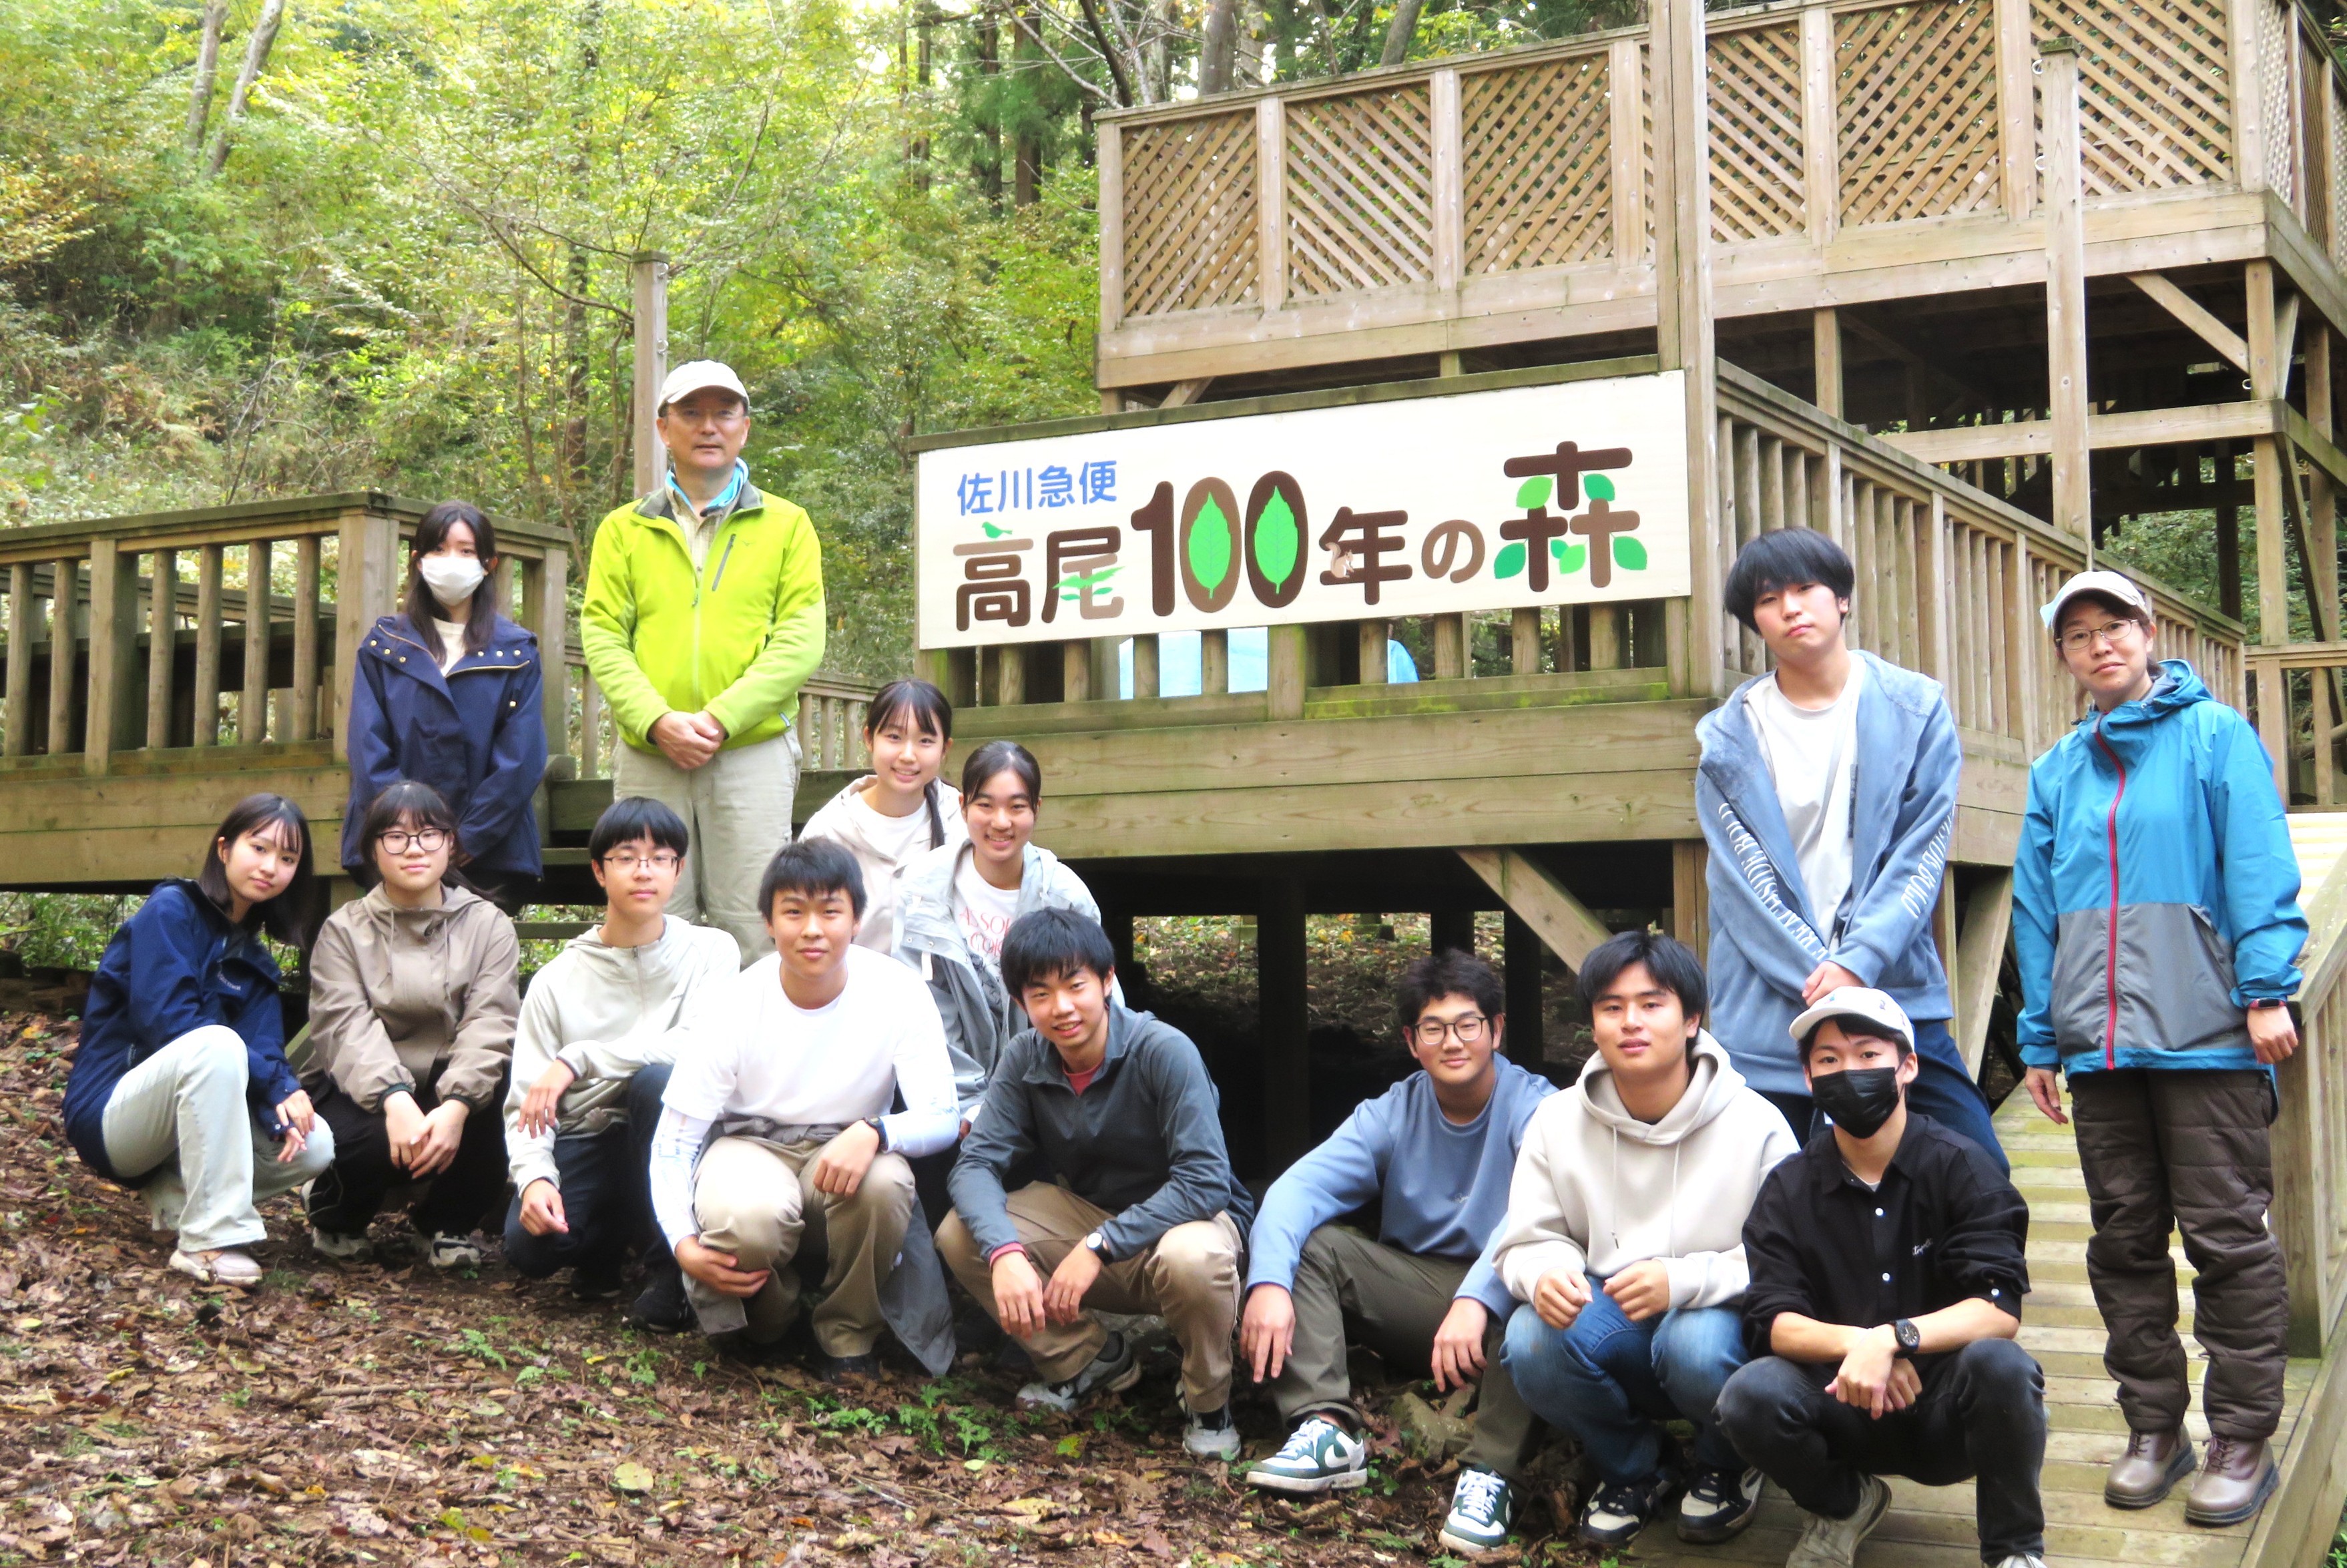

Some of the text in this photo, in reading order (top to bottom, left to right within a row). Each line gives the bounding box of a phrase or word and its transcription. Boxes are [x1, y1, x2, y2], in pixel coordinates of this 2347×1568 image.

[953, 441, 1647, 631] 高尾100年の森
[957, 461, 1117, 516] 佐川急便
